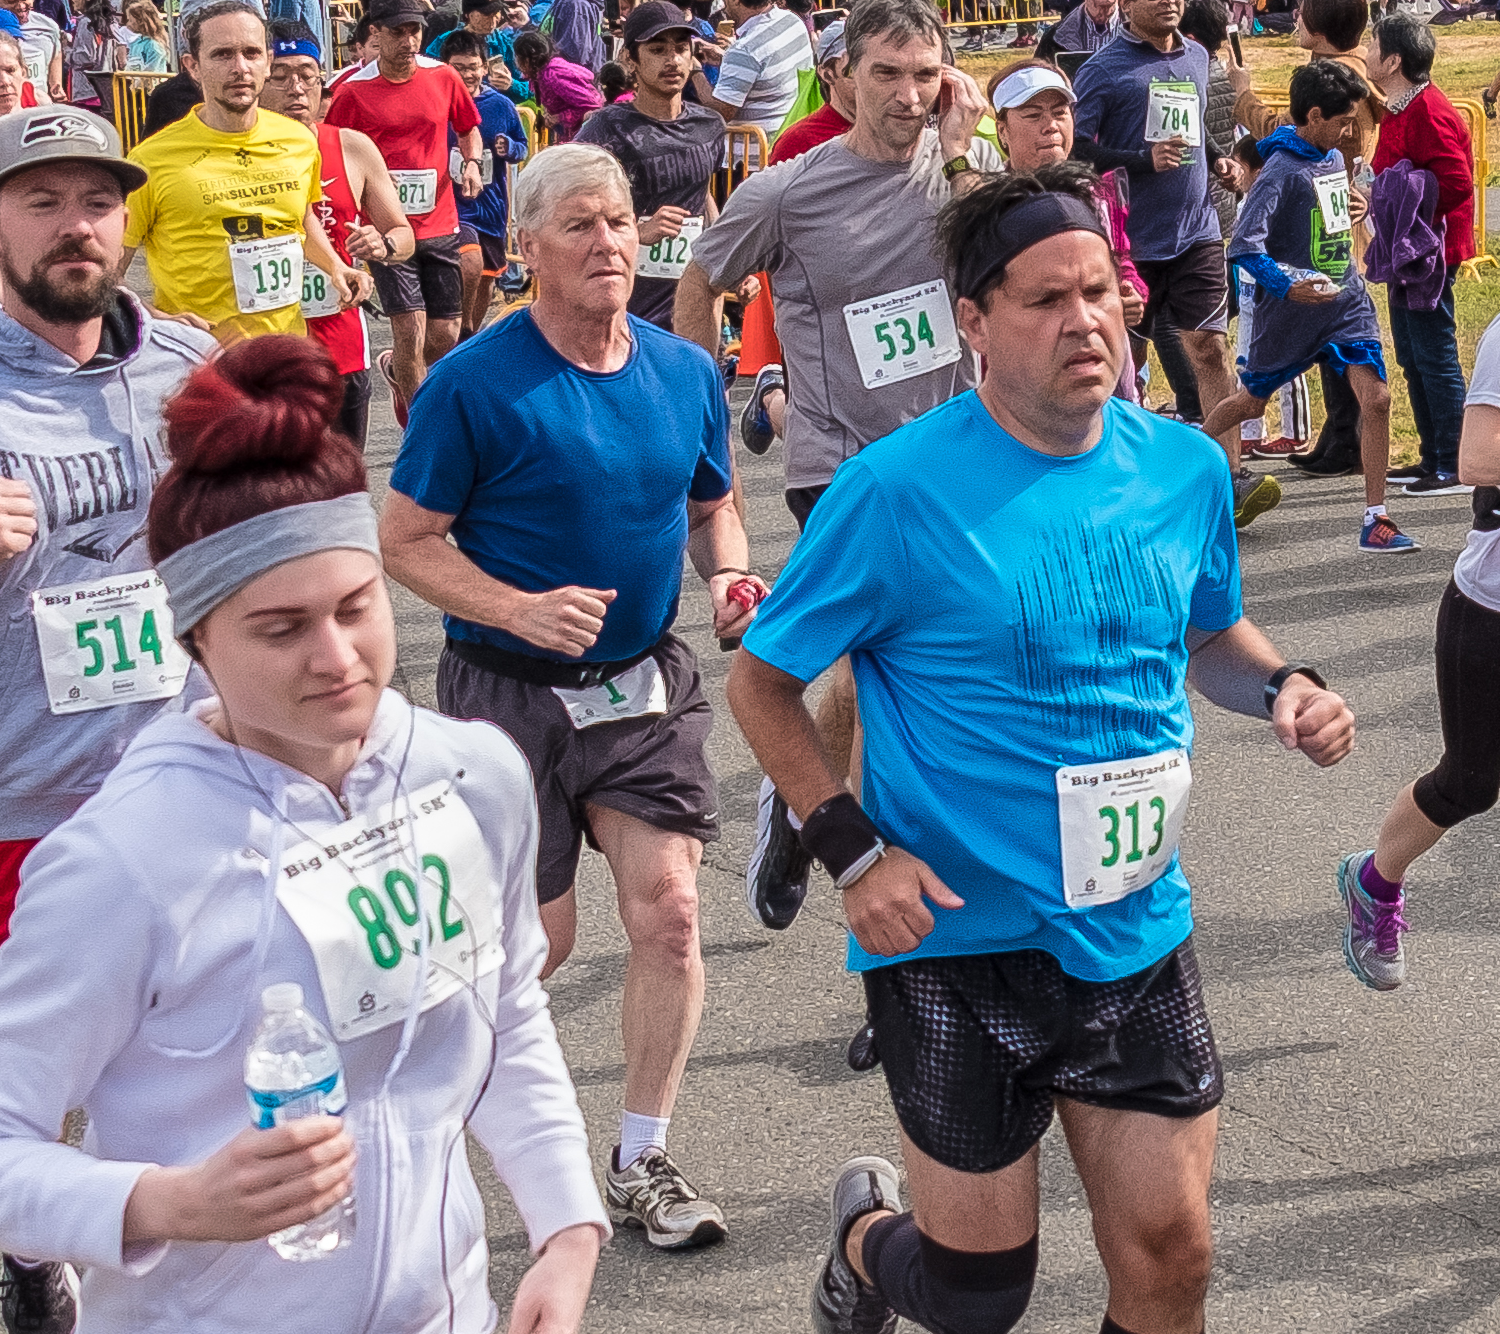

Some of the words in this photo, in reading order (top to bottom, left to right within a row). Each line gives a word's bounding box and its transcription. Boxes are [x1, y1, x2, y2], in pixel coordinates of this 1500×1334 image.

[1161, 106, 1189, 132] 784
[202, 180, 301, 205] SANSILVESTRE
[399, 183, 427, 205] 871
[649, 236, 689, 264] 812
[252, 257, 292, 295] 139
[851, 307, 870, 317] Big
[874, 310, 935, 362] 534
[44, 595, 72, 606] Big
[75, 579, 150, 601] Backyard
[75, 609, 164, 677] 514
[1070, 774, 1099, 787] Big
[1102, 762, 1166, 783] Backyard
[283, 854, 323, 880] Big
[419, 794, 446, 815] 5K
[1098, 795, 1166, 867] 313
[347, 852, 466, 970] 892
